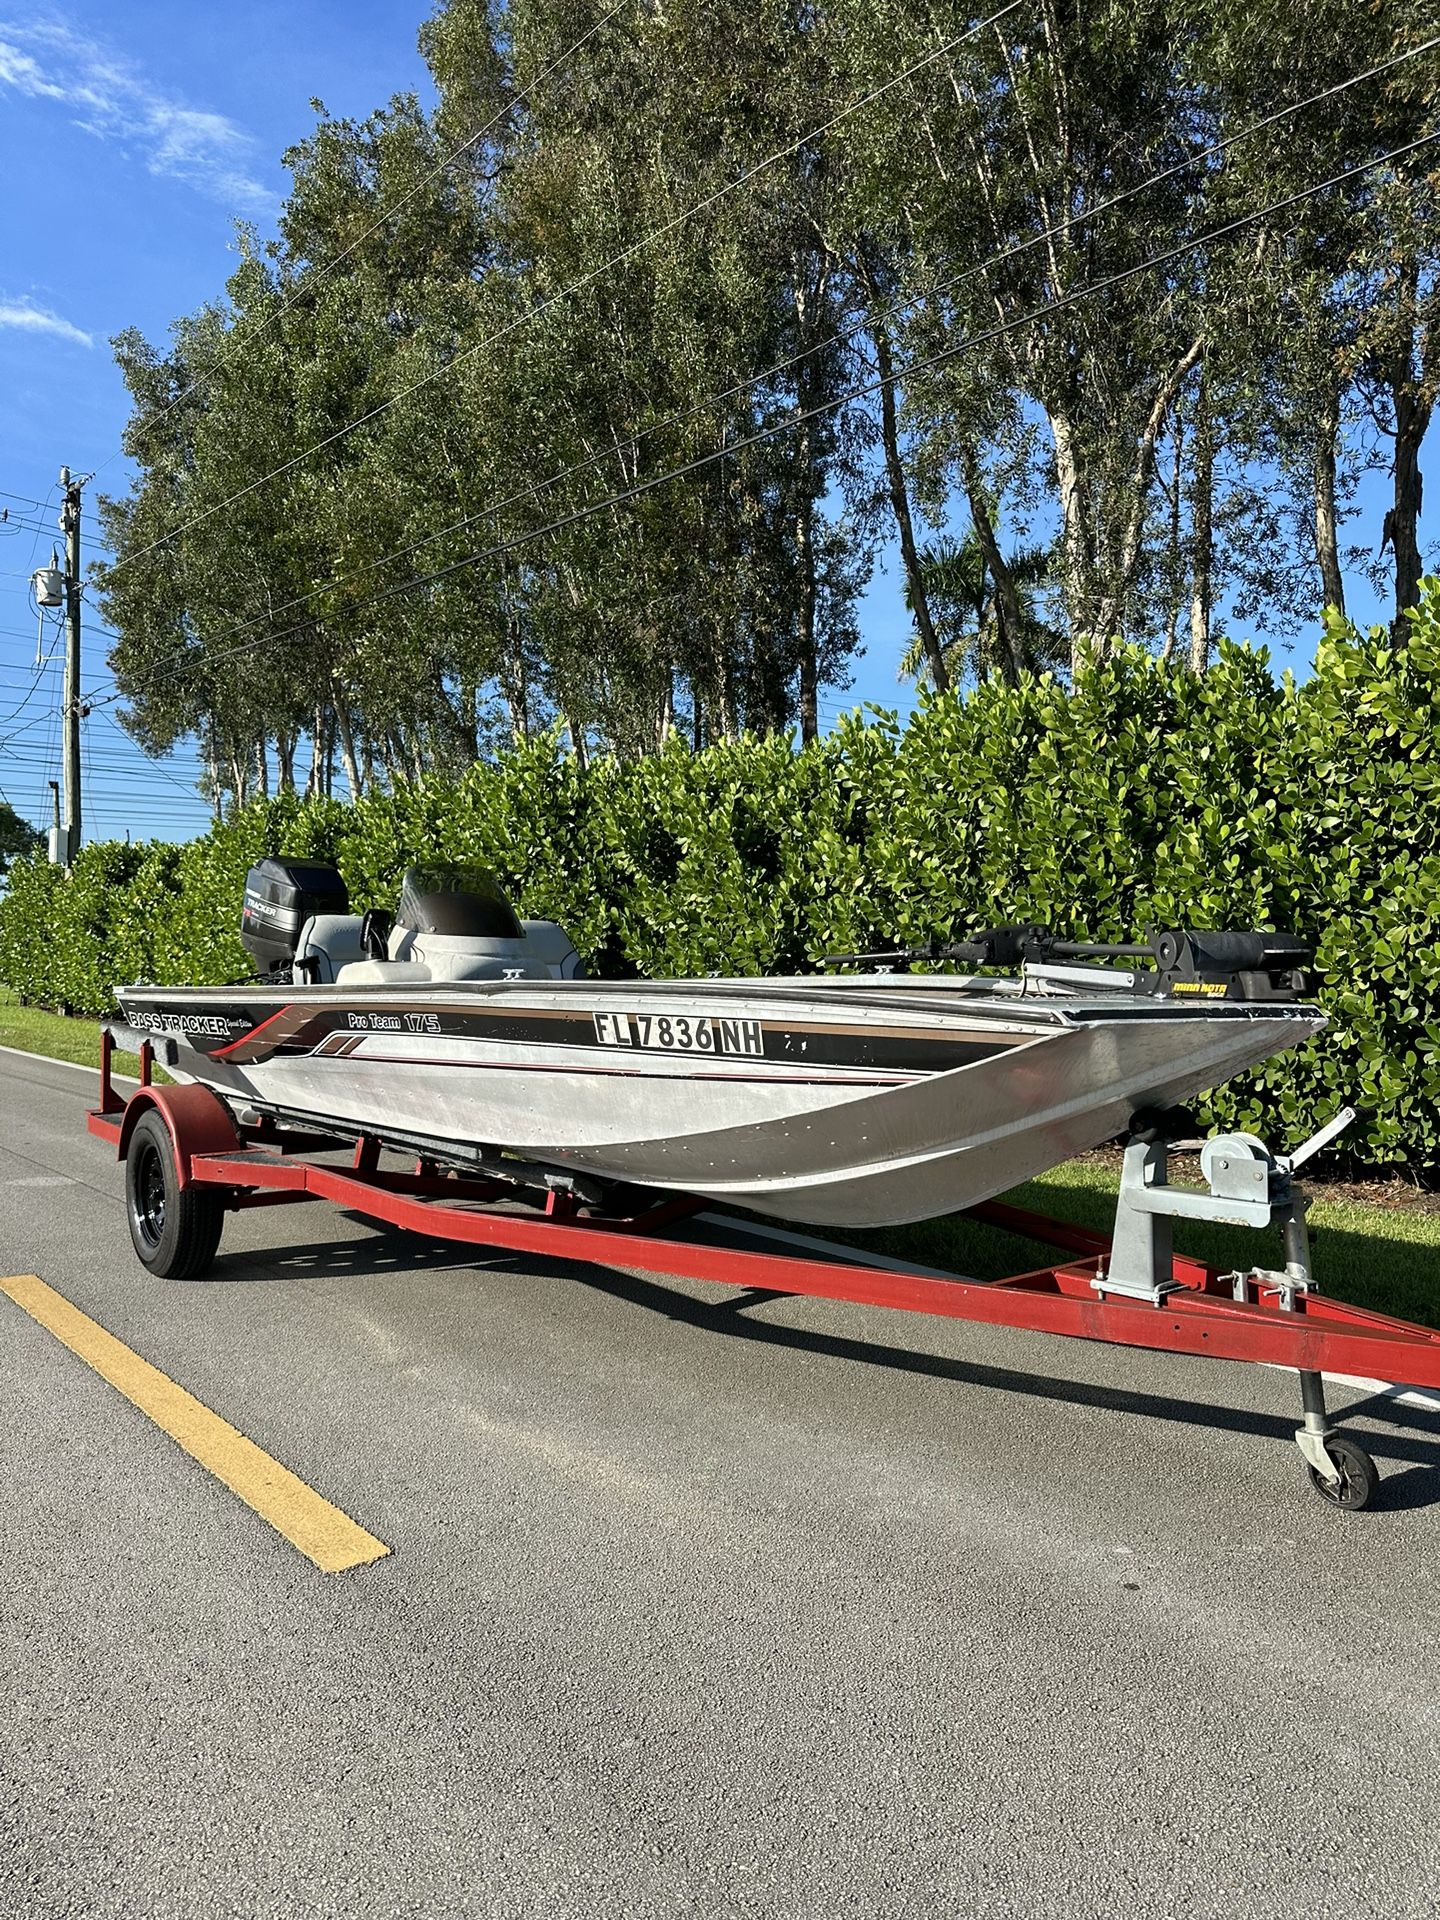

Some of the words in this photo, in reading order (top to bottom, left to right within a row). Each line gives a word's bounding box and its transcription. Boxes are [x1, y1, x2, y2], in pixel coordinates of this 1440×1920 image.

[247, 898, 276, 916] TRACKER
[1200, 984, 1227, 992] KOTA
[128, 1011, 161, 1030] BASS
[161, 1014, 230, 1035] TRACKER
[348, 1013, 368, 1029] Pro
[368, 1013, 401, 1029] Team
[404, 1013, 442, 1032] 175
[594, 1013, 630, 1044] FL
[638, 1016, 712, 1049] 7836
[721, 1020, 762, 1053] NH
